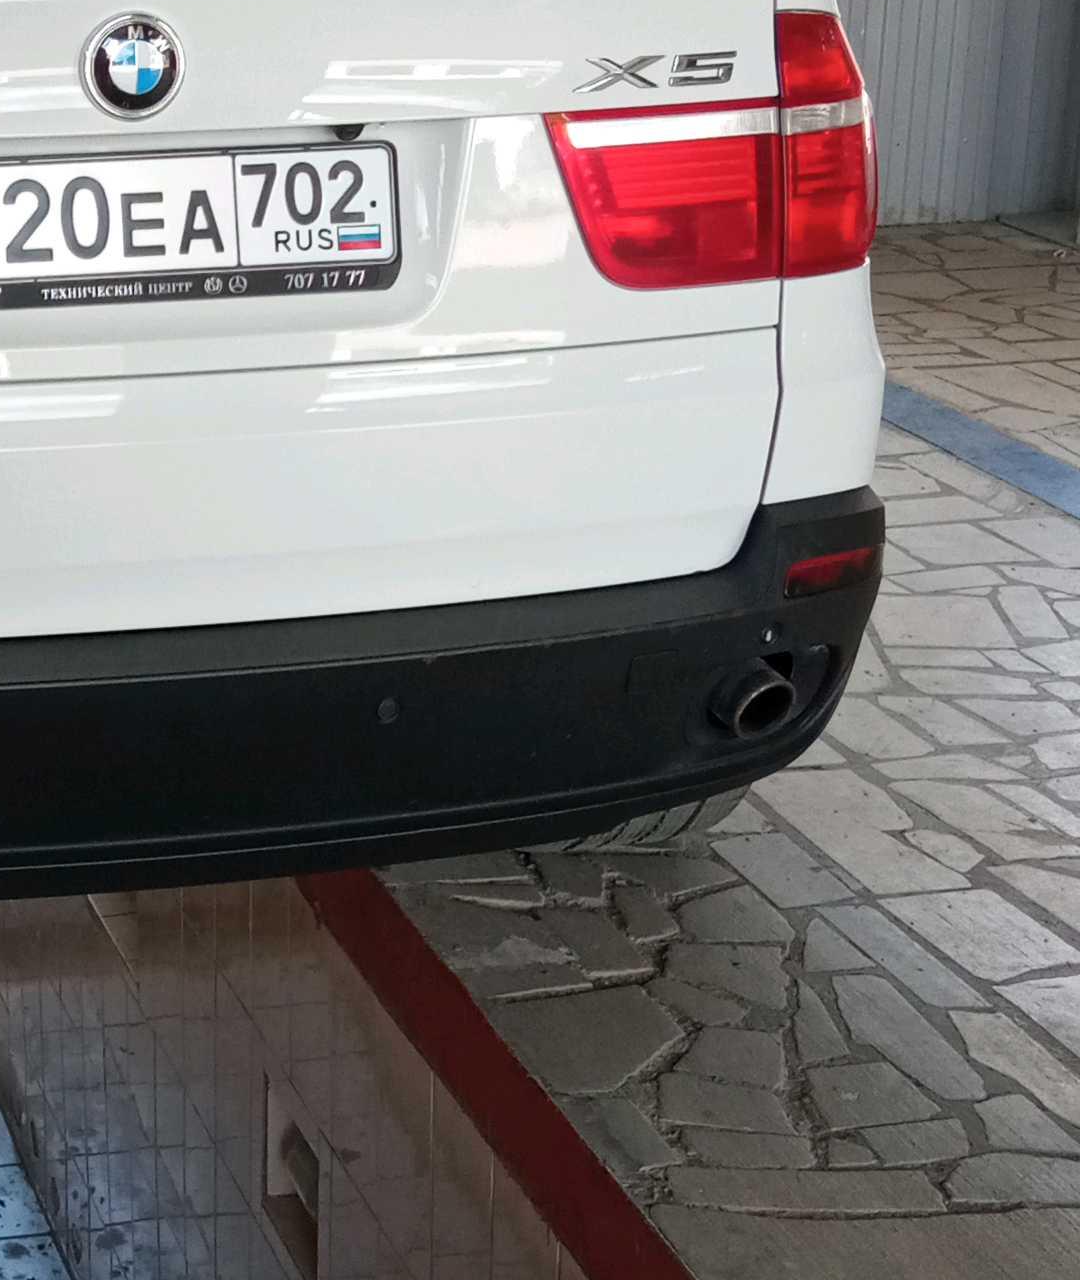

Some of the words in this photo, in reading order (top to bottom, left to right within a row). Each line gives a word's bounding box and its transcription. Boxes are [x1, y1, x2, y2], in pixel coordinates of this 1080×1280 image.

[572, 50, 737, 94] X5
[241, 159, 365, 229] 702
[274, 228, 334, 253] RUS
[41, 283, 143, 301] ТЕХНИЧЕСКИЙ
[148, 281, 193, 296] ЦЕНТР
[284, 273, 314, 290] 707
[321, 271, 341, 288] 17
[346, 269, 366, 287] 77
